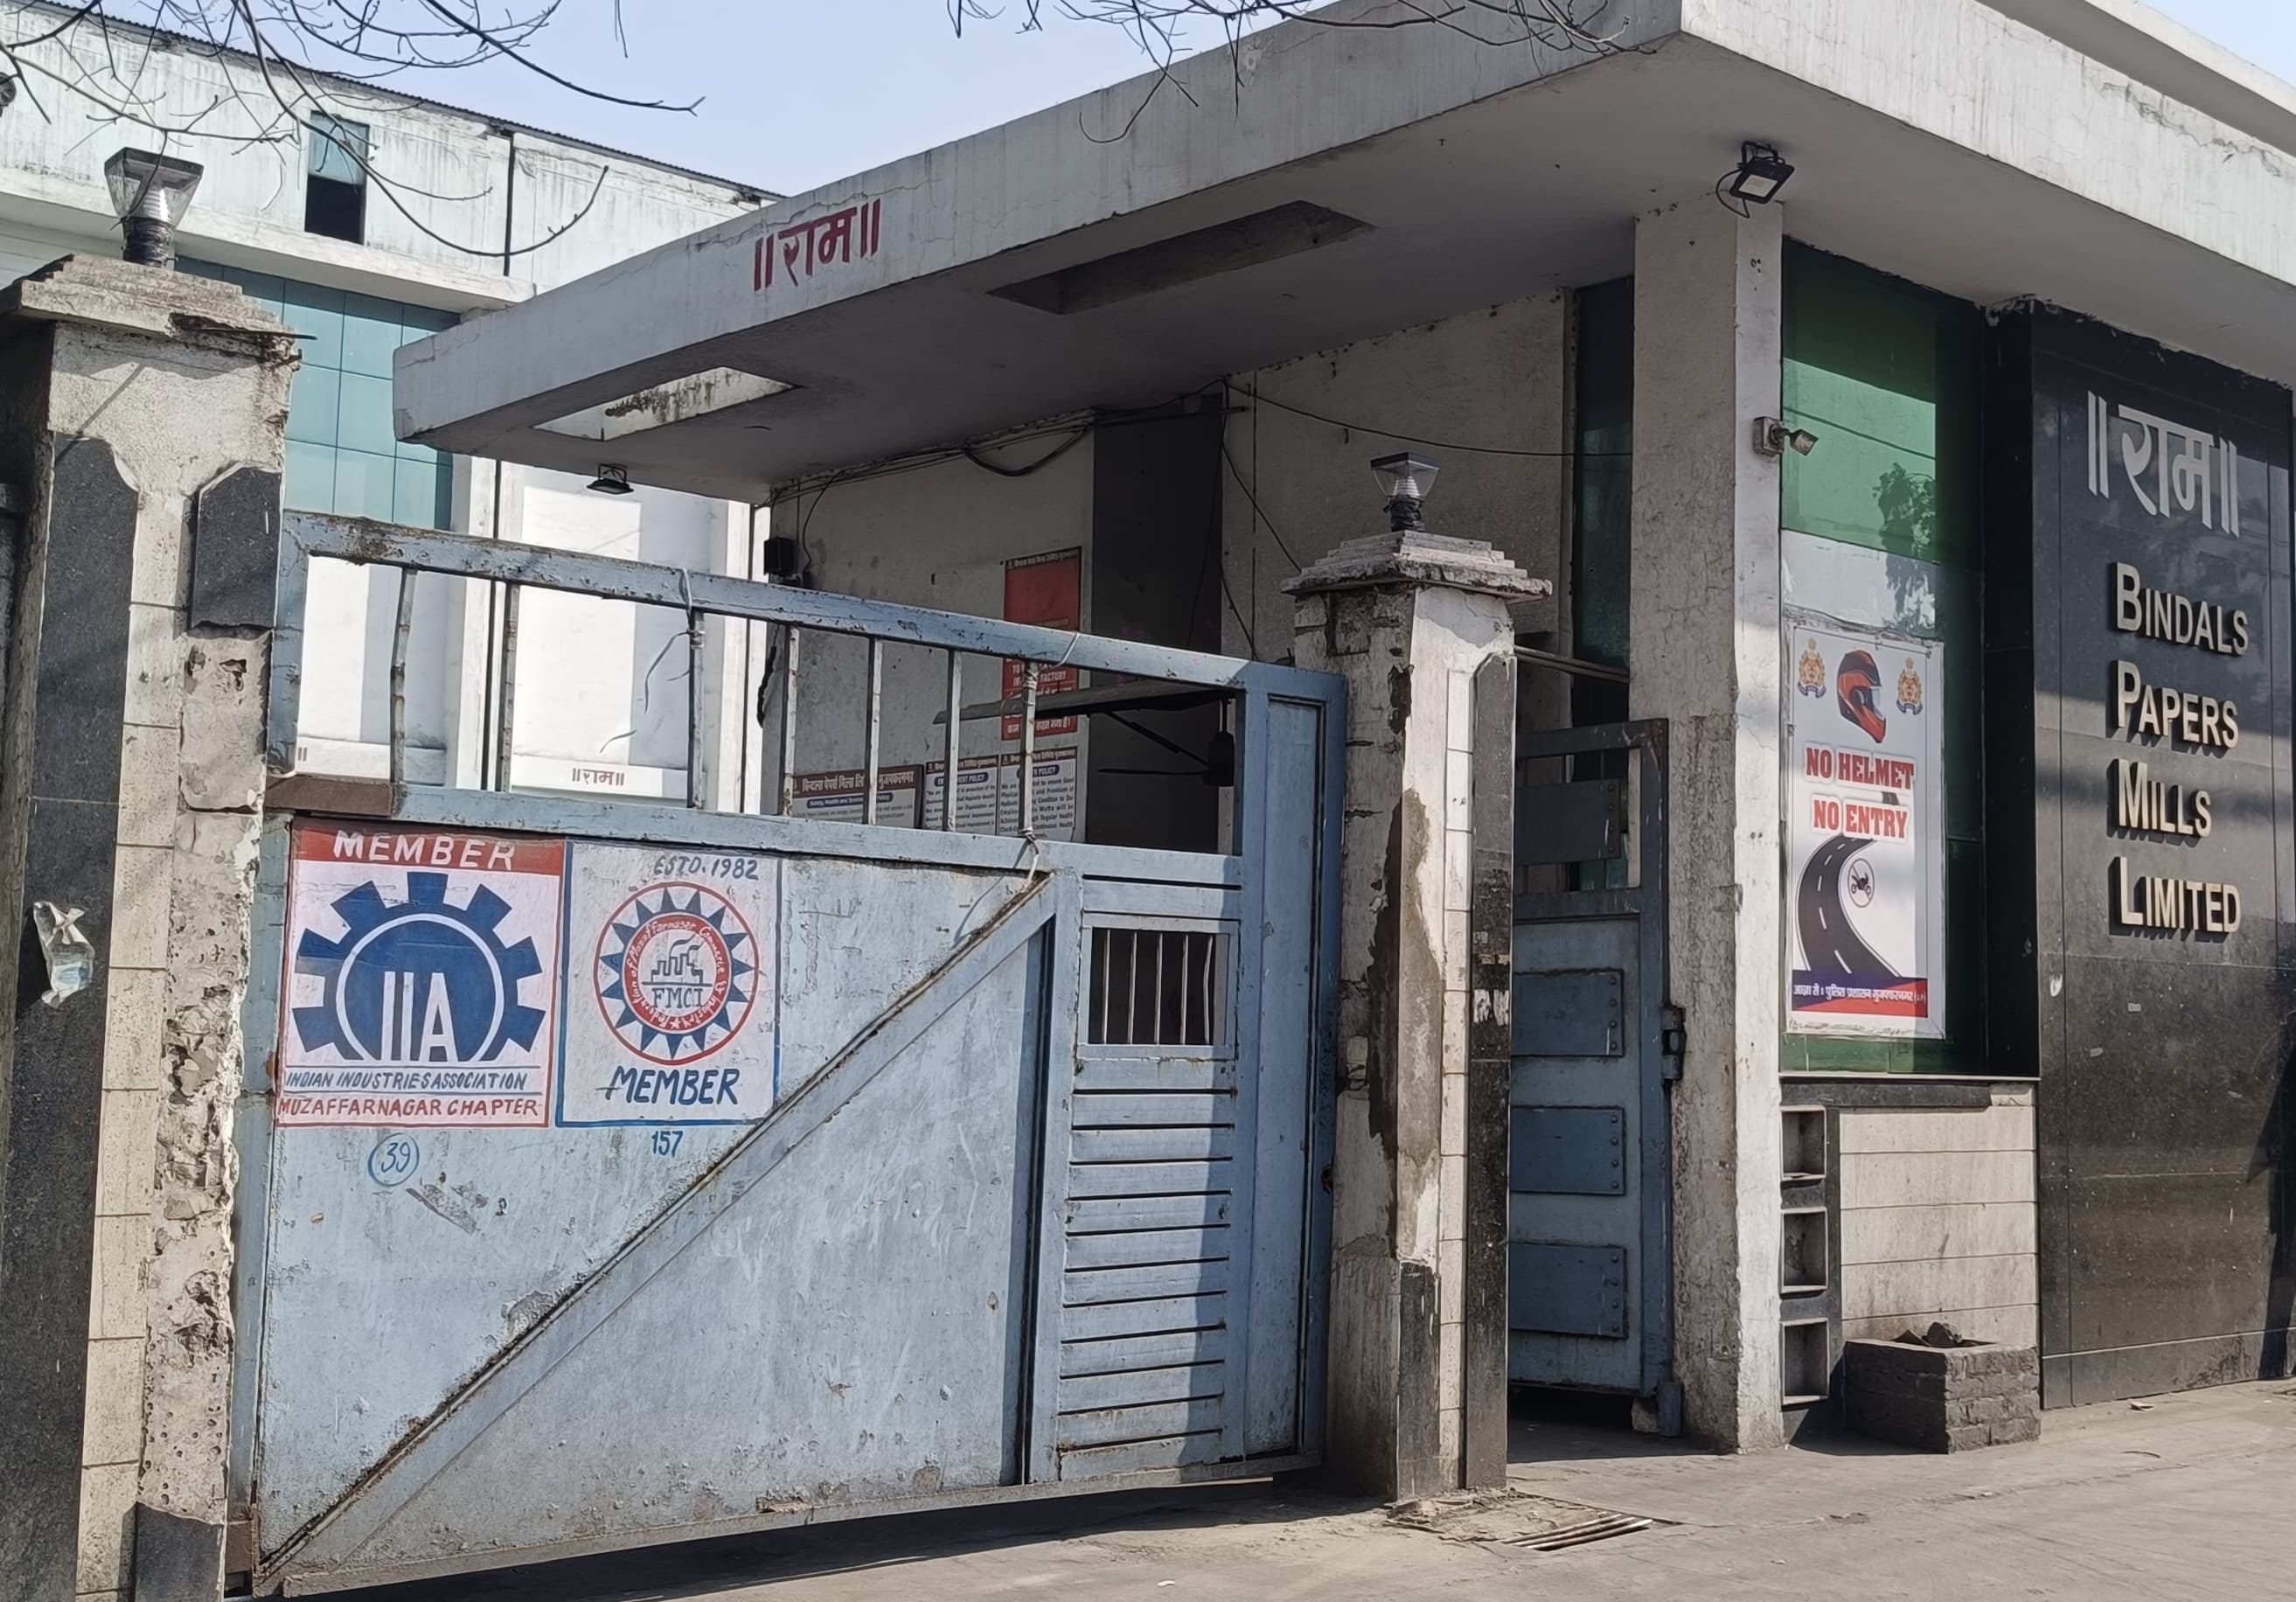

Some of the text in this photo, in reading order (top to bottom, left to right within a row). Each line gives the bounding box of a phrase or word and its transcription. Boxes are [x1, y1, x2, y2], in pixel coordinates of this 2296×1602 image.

[2117, 561, 2249, 656] BINDALS
[1040, 672, 1067, 682] FACTORY
[2118, 659, 2239, 749] PAPERS
[1806, 747, 1914, 791] NO HELMET
[2119, 759, 2211, 838] MILLS
[1813, 799, 1907, 839] NO ENTRY
[333, 829, 515, 871] MEMBER
[2120, 857, 2241, 933] LIMITED
[381, 971, 458, 1062] IIA
[651, 987, 704, 1008] FMCI
[285, 1071, 333, 1088] INDIAN
[605, 1065, 740, 1105] MEMBER
[277, 1097, 539, 1118] MUZAFFARNAGAR CHAPTER
[381, 1141, 411, 1173] 39
[651, 1131, 684, 1158] 157
